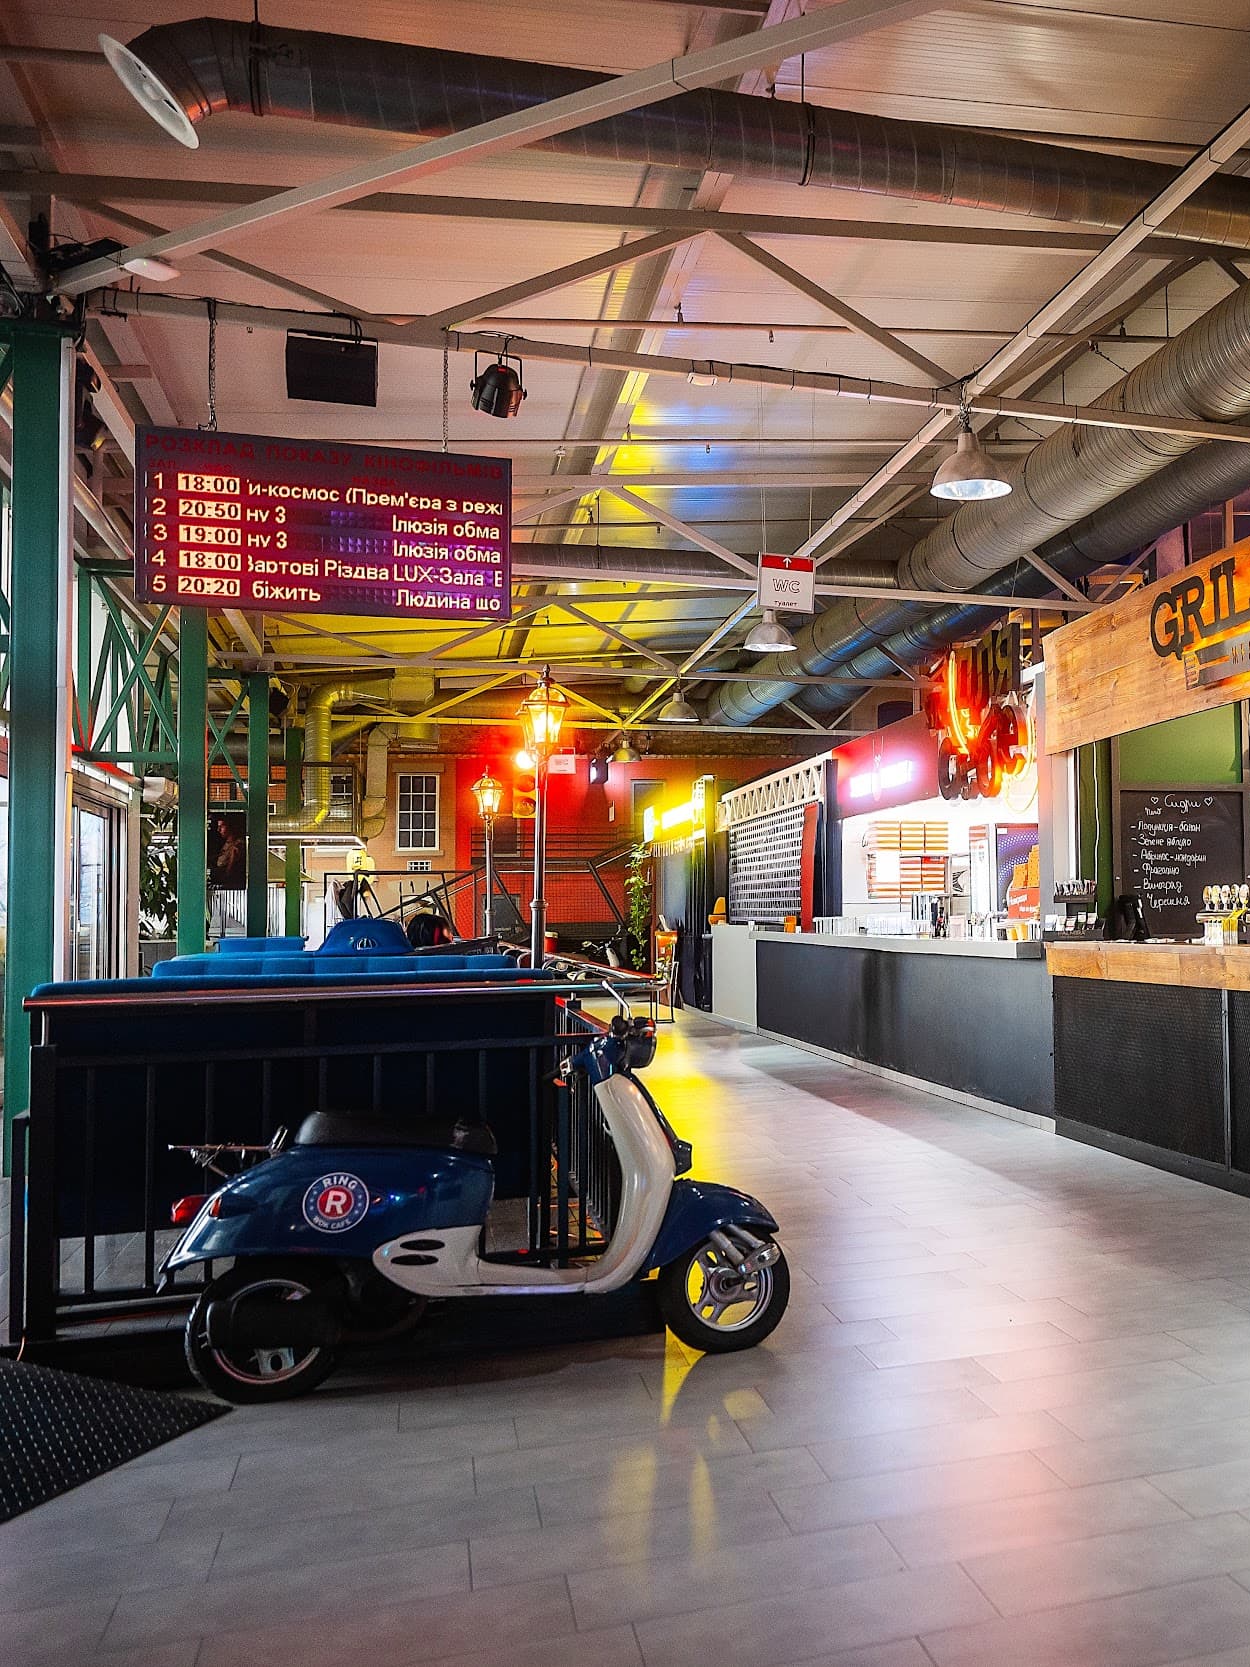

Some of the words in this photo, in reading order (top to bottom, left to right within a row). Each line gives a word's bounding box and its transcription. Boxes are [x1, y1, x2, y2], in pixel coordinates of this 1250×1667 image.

[153, 472, 163, 490] 1
[181, 474, 238, 493] 18:00
[446, 500, 457, 511] з
[152, 498, 167, 516] 2
[181, 500, 239, 518] 20:50
[274, 505, 287, 524] 3
[392, 514, 448, 536] Ілюзія
[153, 523, 168, 541] 3
[182, 526, 239, 544] 19:00
[275, 531, 288, 550] 3
[393, 539, 449, 560] Ілюзія
[151, 549, 167, 567] 4
[182, 551, 239, 570] 18:00
[393, 563, 484, 586] LUX-Зала
[152, 575, 168, 592] 5
[180, 577, 239, 596] 20:20
[252, 580, 321, 602] біжить
[772, 578, 801, 594] WC
[322, 1175, 358, 1190] RING
[324, 1190, 347, 1215] R
